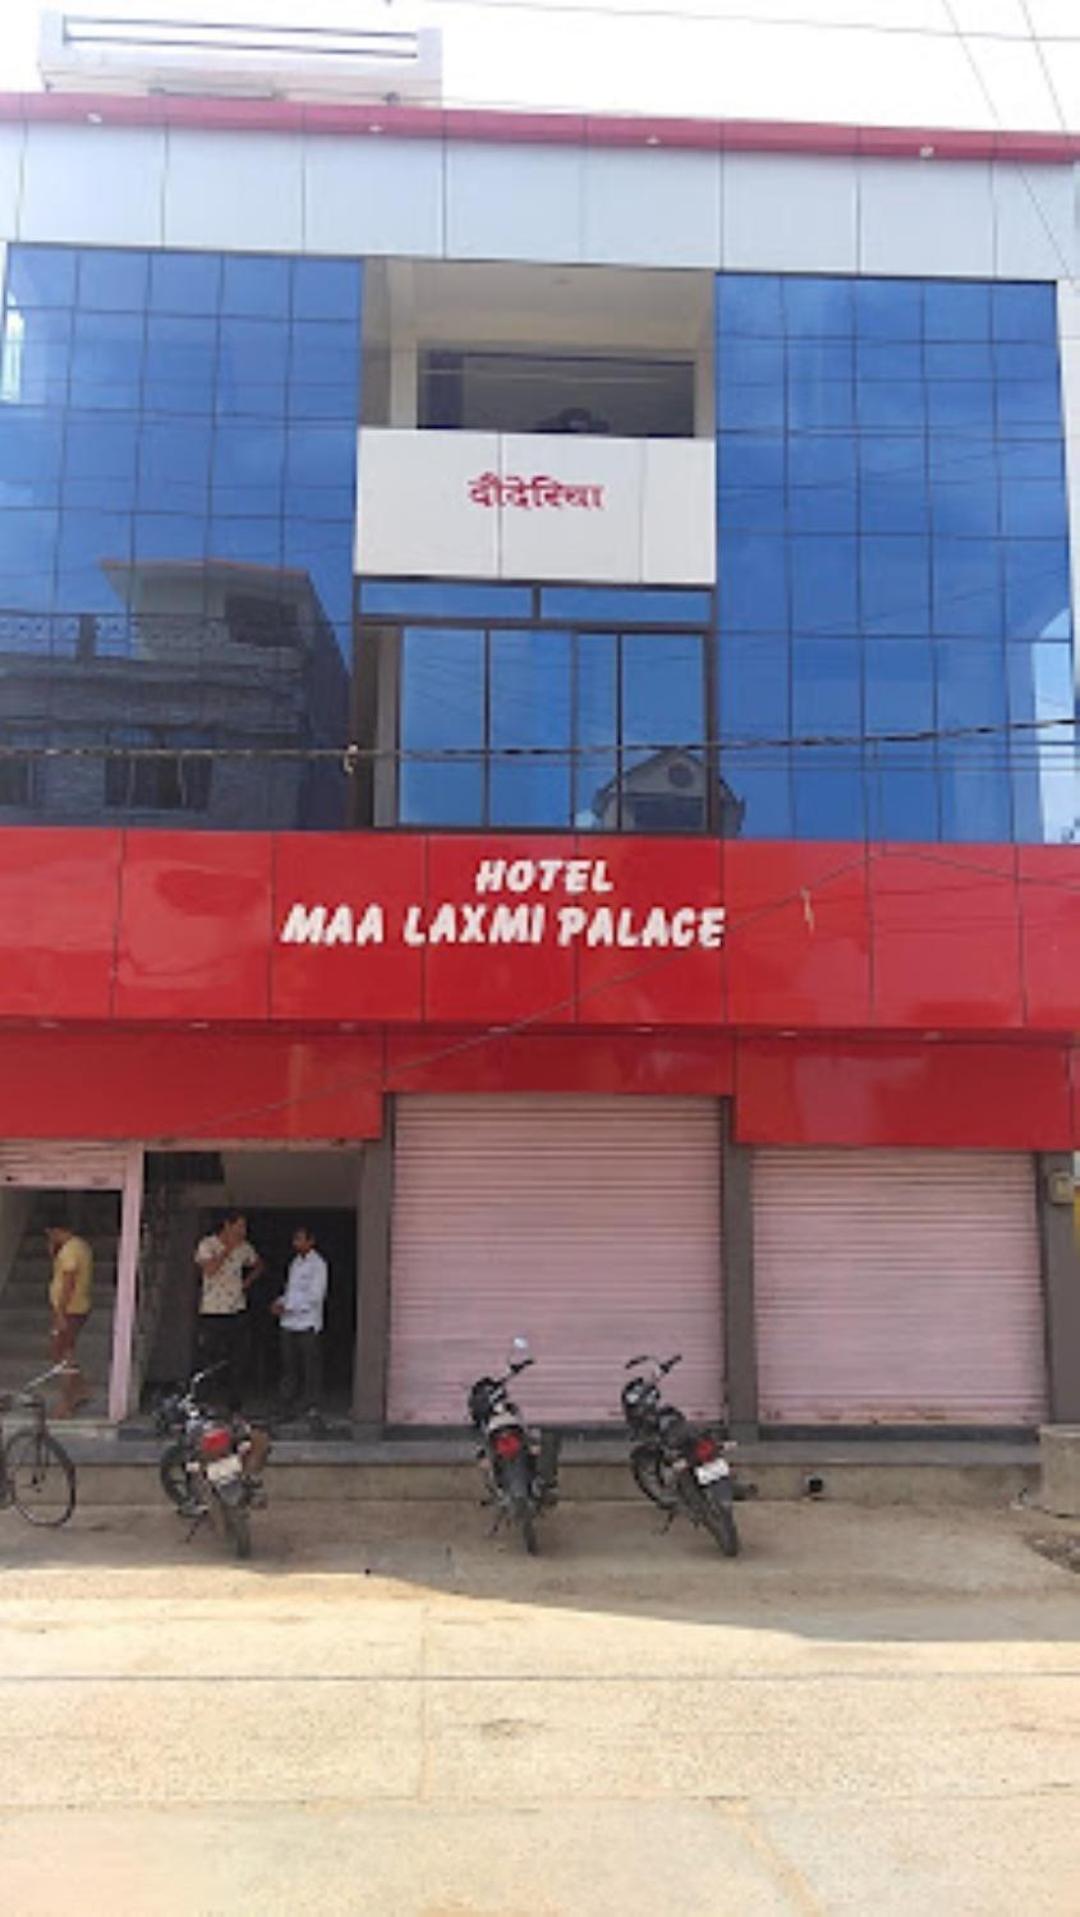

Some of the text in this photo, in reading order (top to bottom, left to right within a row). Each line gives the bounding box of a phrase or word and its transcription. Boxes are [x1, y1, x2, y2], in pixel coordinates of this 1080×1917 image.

[476, 860, 613, 893] HOTEL
[280, 904, 726, 948] MAA LAXMI PALACE
